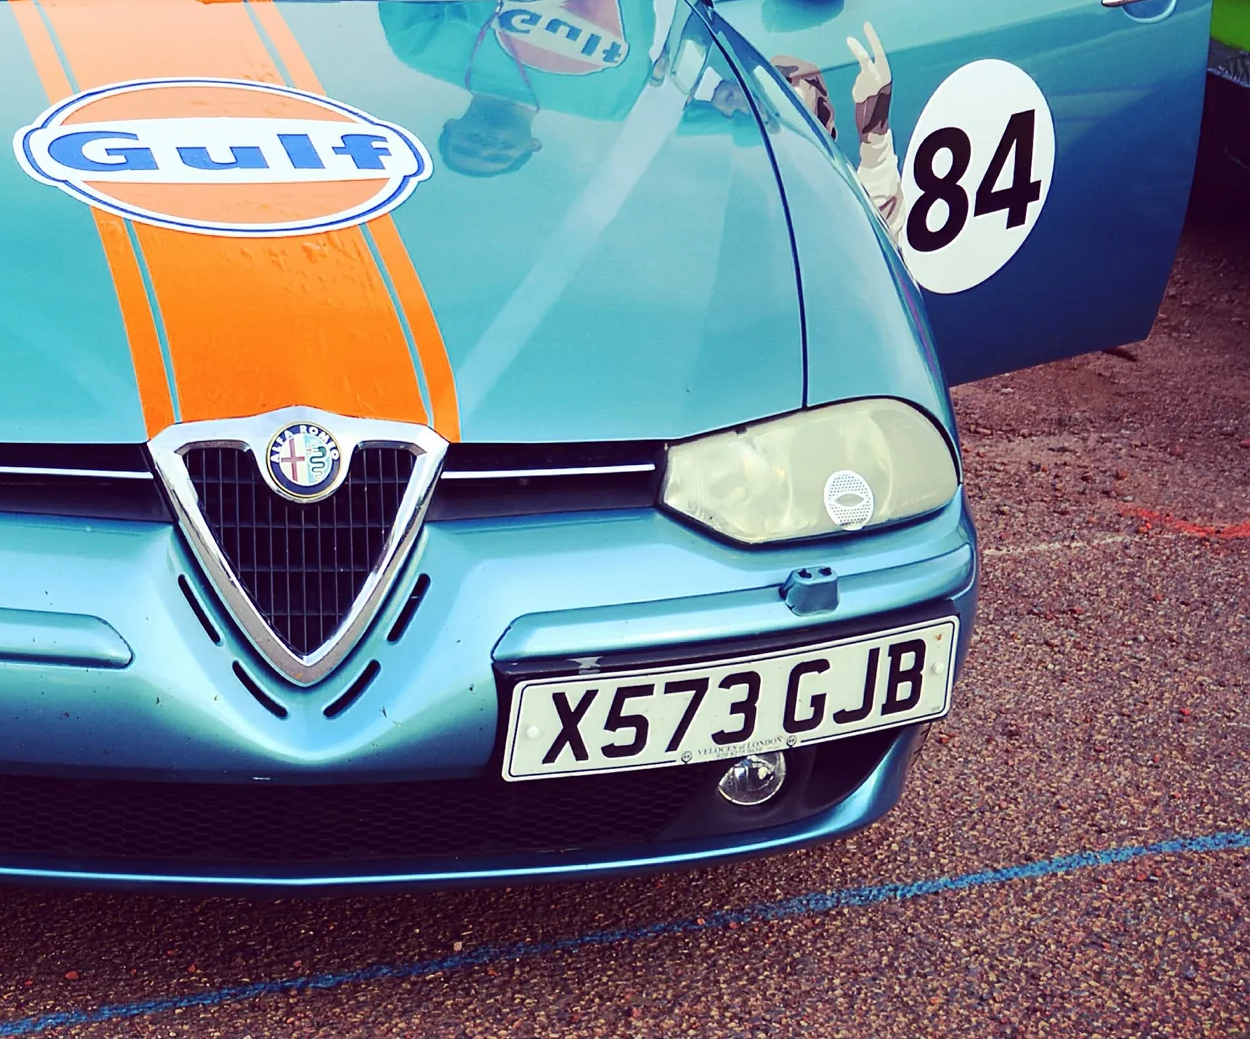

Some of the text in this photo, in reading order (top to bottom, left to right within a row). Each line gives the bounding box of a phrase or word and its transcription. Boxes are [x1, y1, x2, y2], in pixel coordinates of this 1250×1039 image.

[47, 129, 394, 173] Gulf
[905, 108, 1042, 253] 84
[270, 425, 340, 463] ALFA ROMEO
[541, 637, 928, 765] X573 GJB
[745, 736, 783, 749] LONDON
